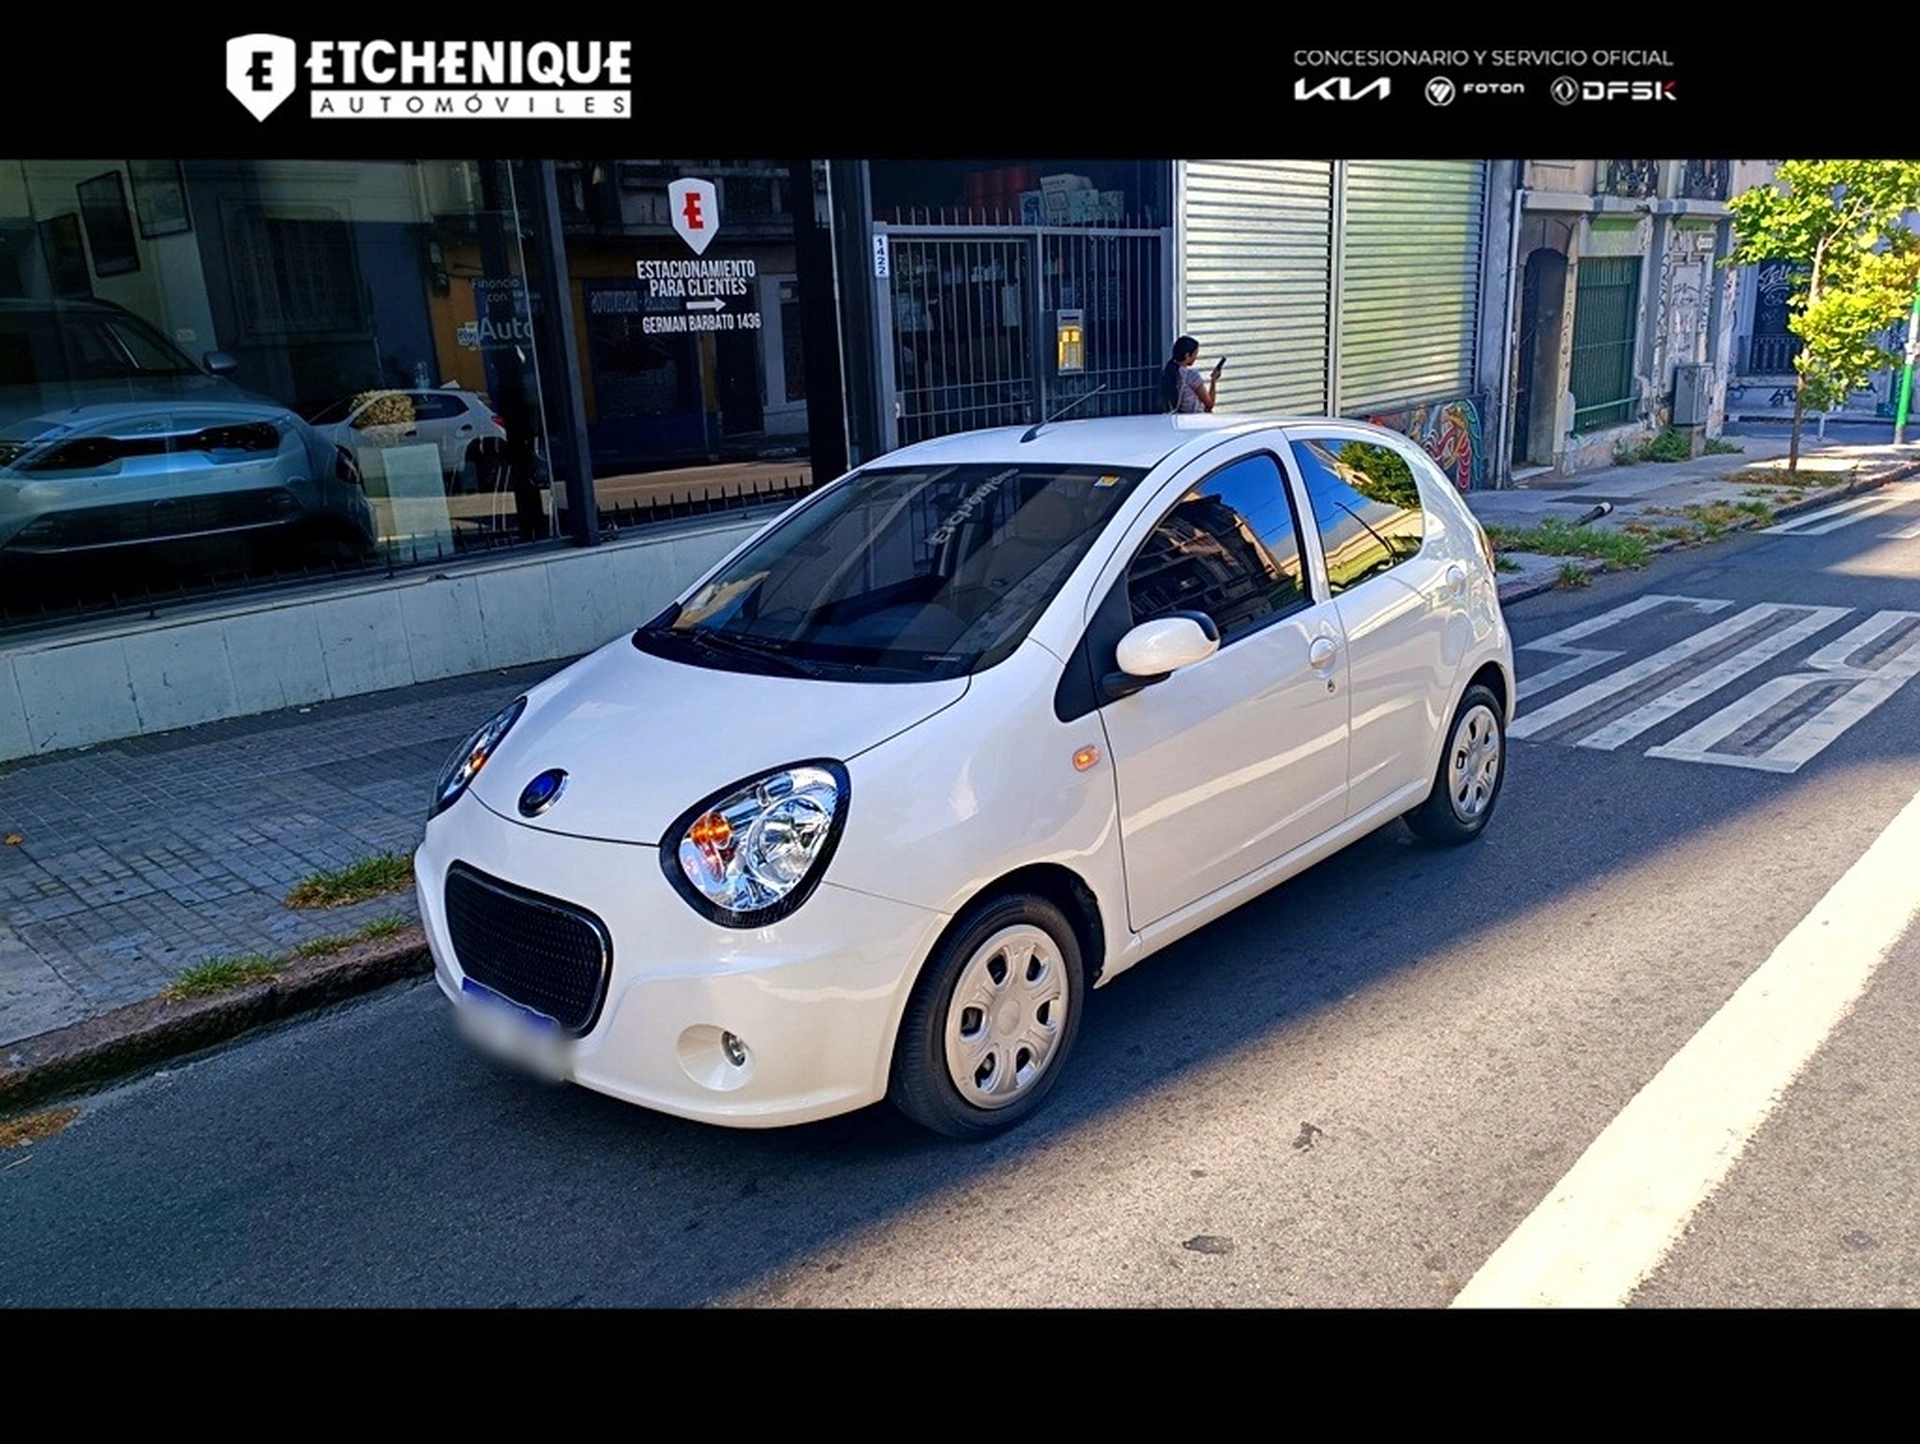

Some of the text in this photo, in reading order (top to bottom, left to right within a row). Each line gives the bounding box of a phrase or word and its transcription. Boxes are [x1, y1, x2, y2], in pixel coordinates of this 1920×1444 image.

[876, 237, 886, 275] 1422
[636, 260, 757, 279] ESTACIONAMIENTO
[650, 278, 747, 297] PARA CLIENTES
[487, 292, 508, 303] con
[642, 317, 687, 334] GERMAN
[688, 314, 735, 332] BARBATO
